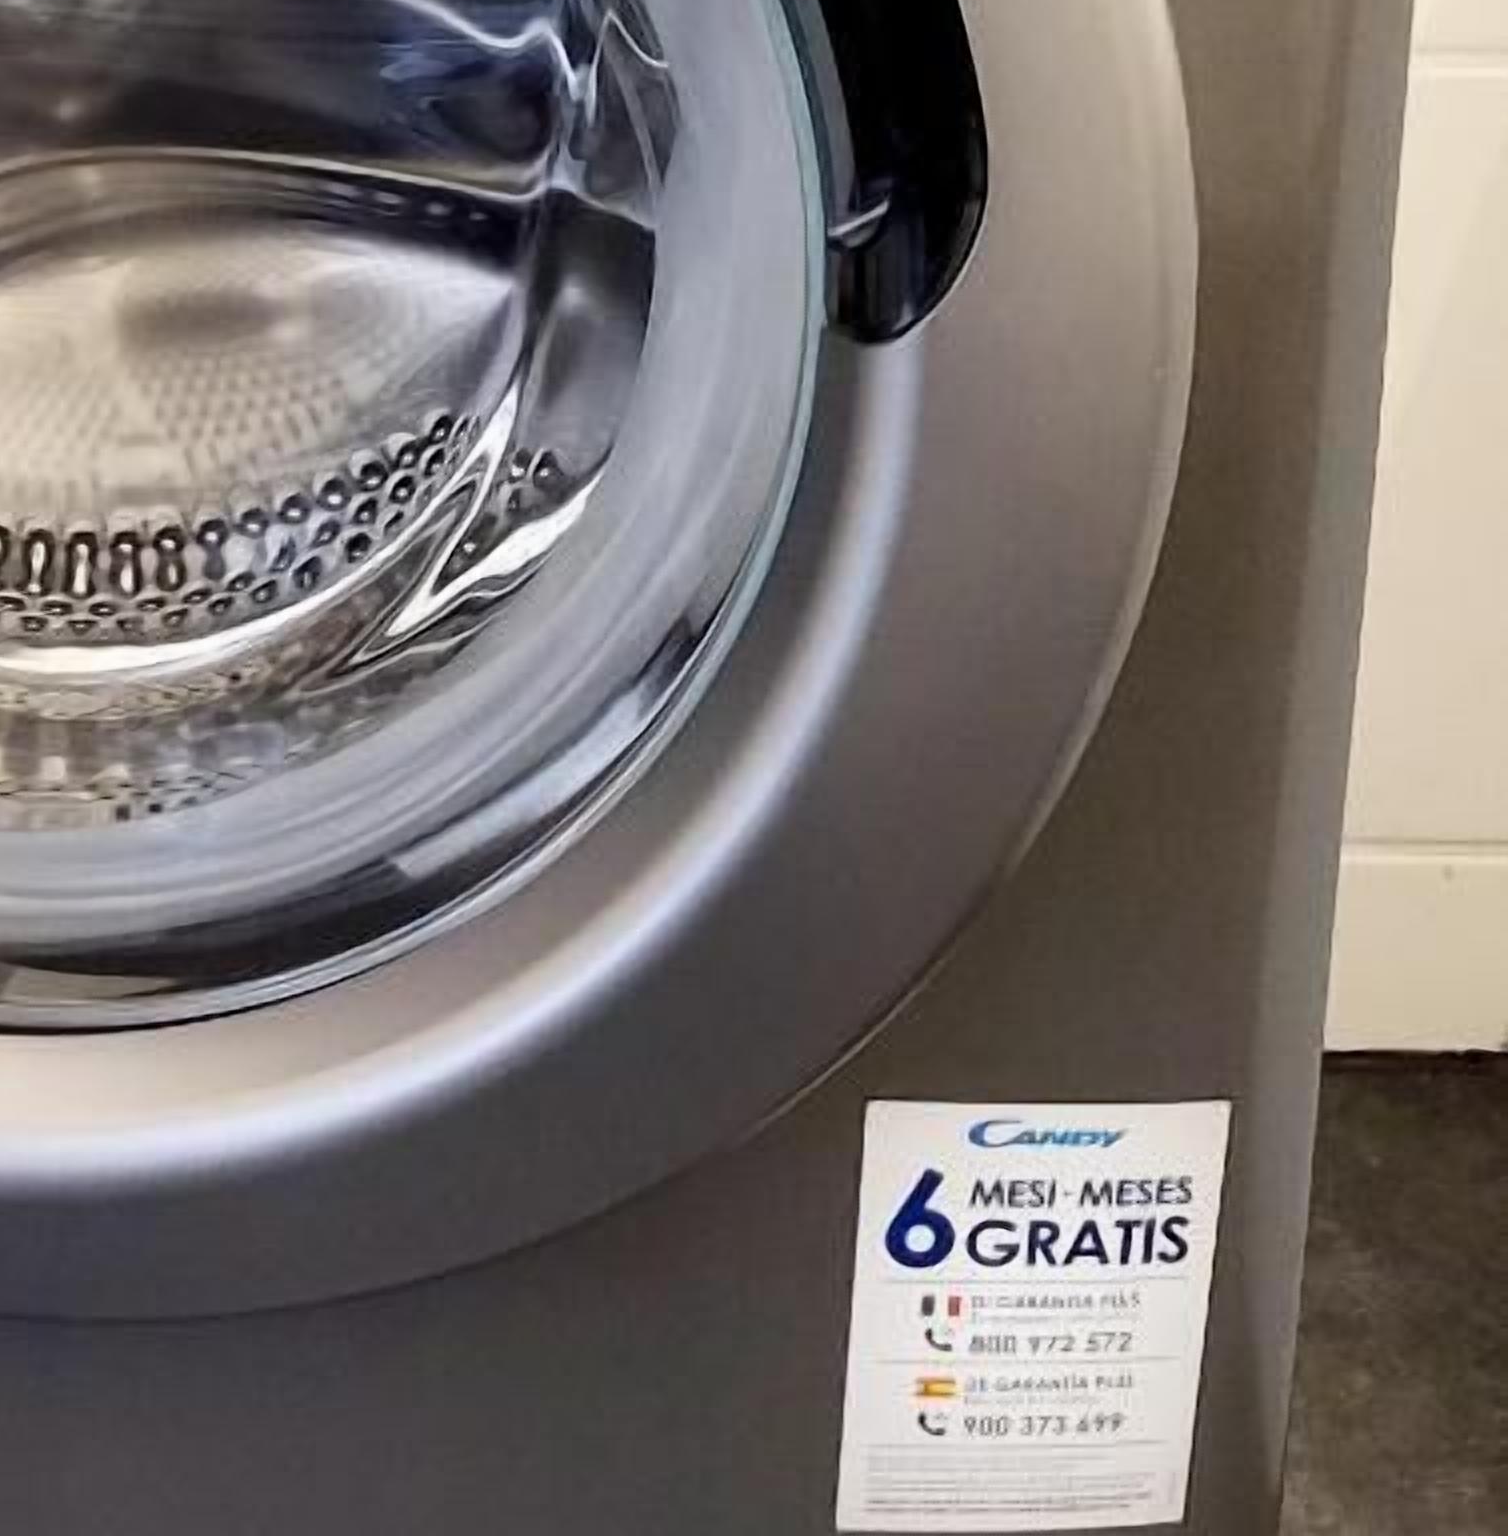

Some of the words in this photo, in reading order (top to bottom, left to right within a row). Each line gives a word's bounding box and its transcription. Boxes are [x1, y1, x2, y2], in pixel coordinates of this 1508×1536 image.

[968, 1119, 1128, 1148] CANDY
[1078, 1175, 1193, 1206] MESES
[884, 1168, 956, 1268] 6
[966, 1215, 1192, 1267] GRATIS
